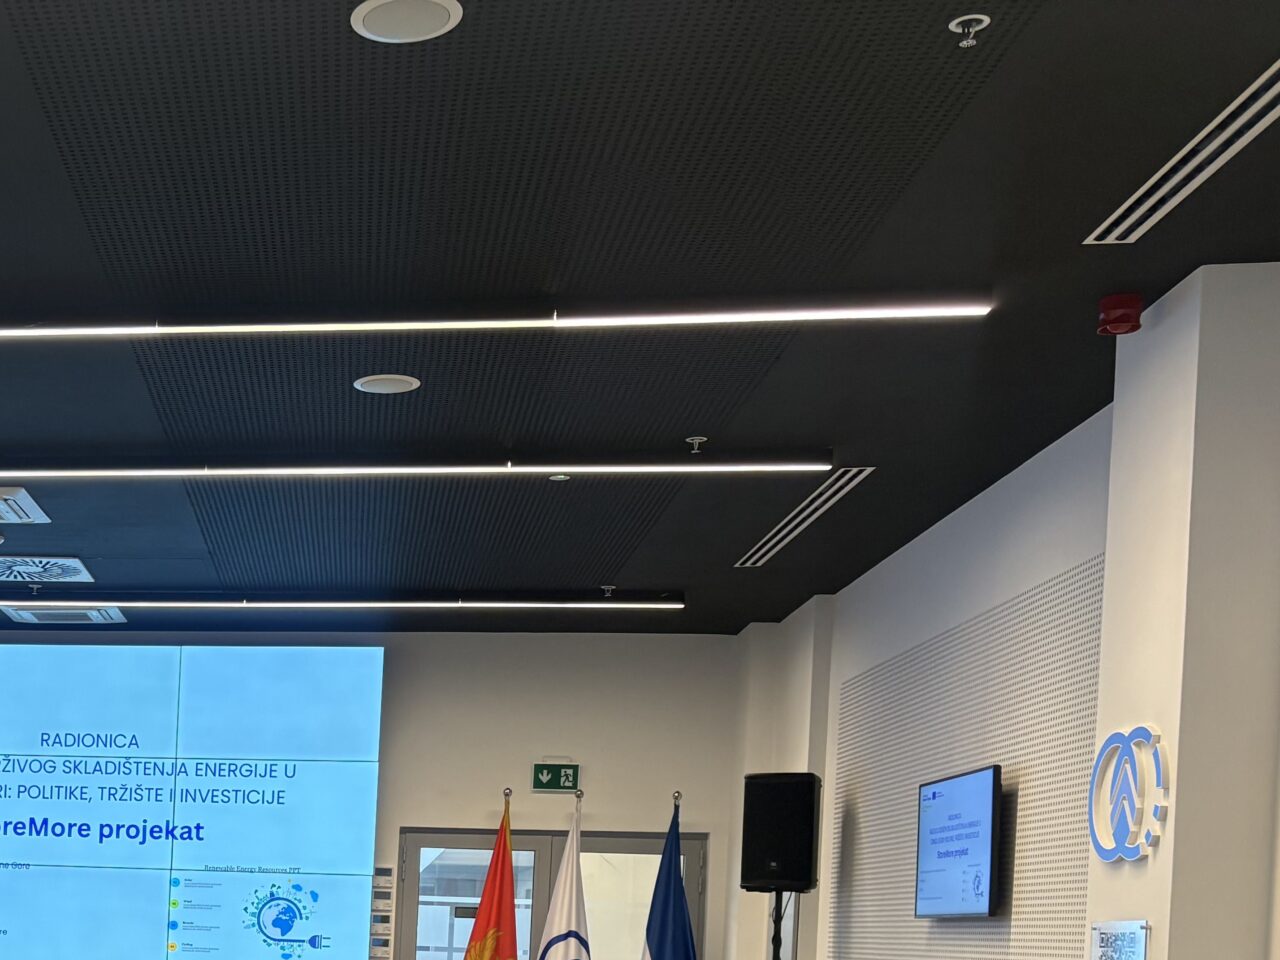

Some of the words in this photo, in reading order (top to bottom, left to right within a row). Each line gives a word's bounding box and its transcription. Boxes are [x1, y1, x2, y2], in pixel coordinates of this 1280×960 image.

[40, 732, 140, 749] RADIONICA
[62, 757, 189, 777] SKLADIŠTENJA
[195, 762, 278, 778] ENERGIJE
[284, 763, 297, 779] U
[17, 784, 93, 803] POLITIKE,
[98, 784, 164, 802] TRŽIŠTE
[180, 788, 286, 805] INVESTICIJE
[98, 818, 205, 845] projekat
[236, 866, 256, 874] Energy
